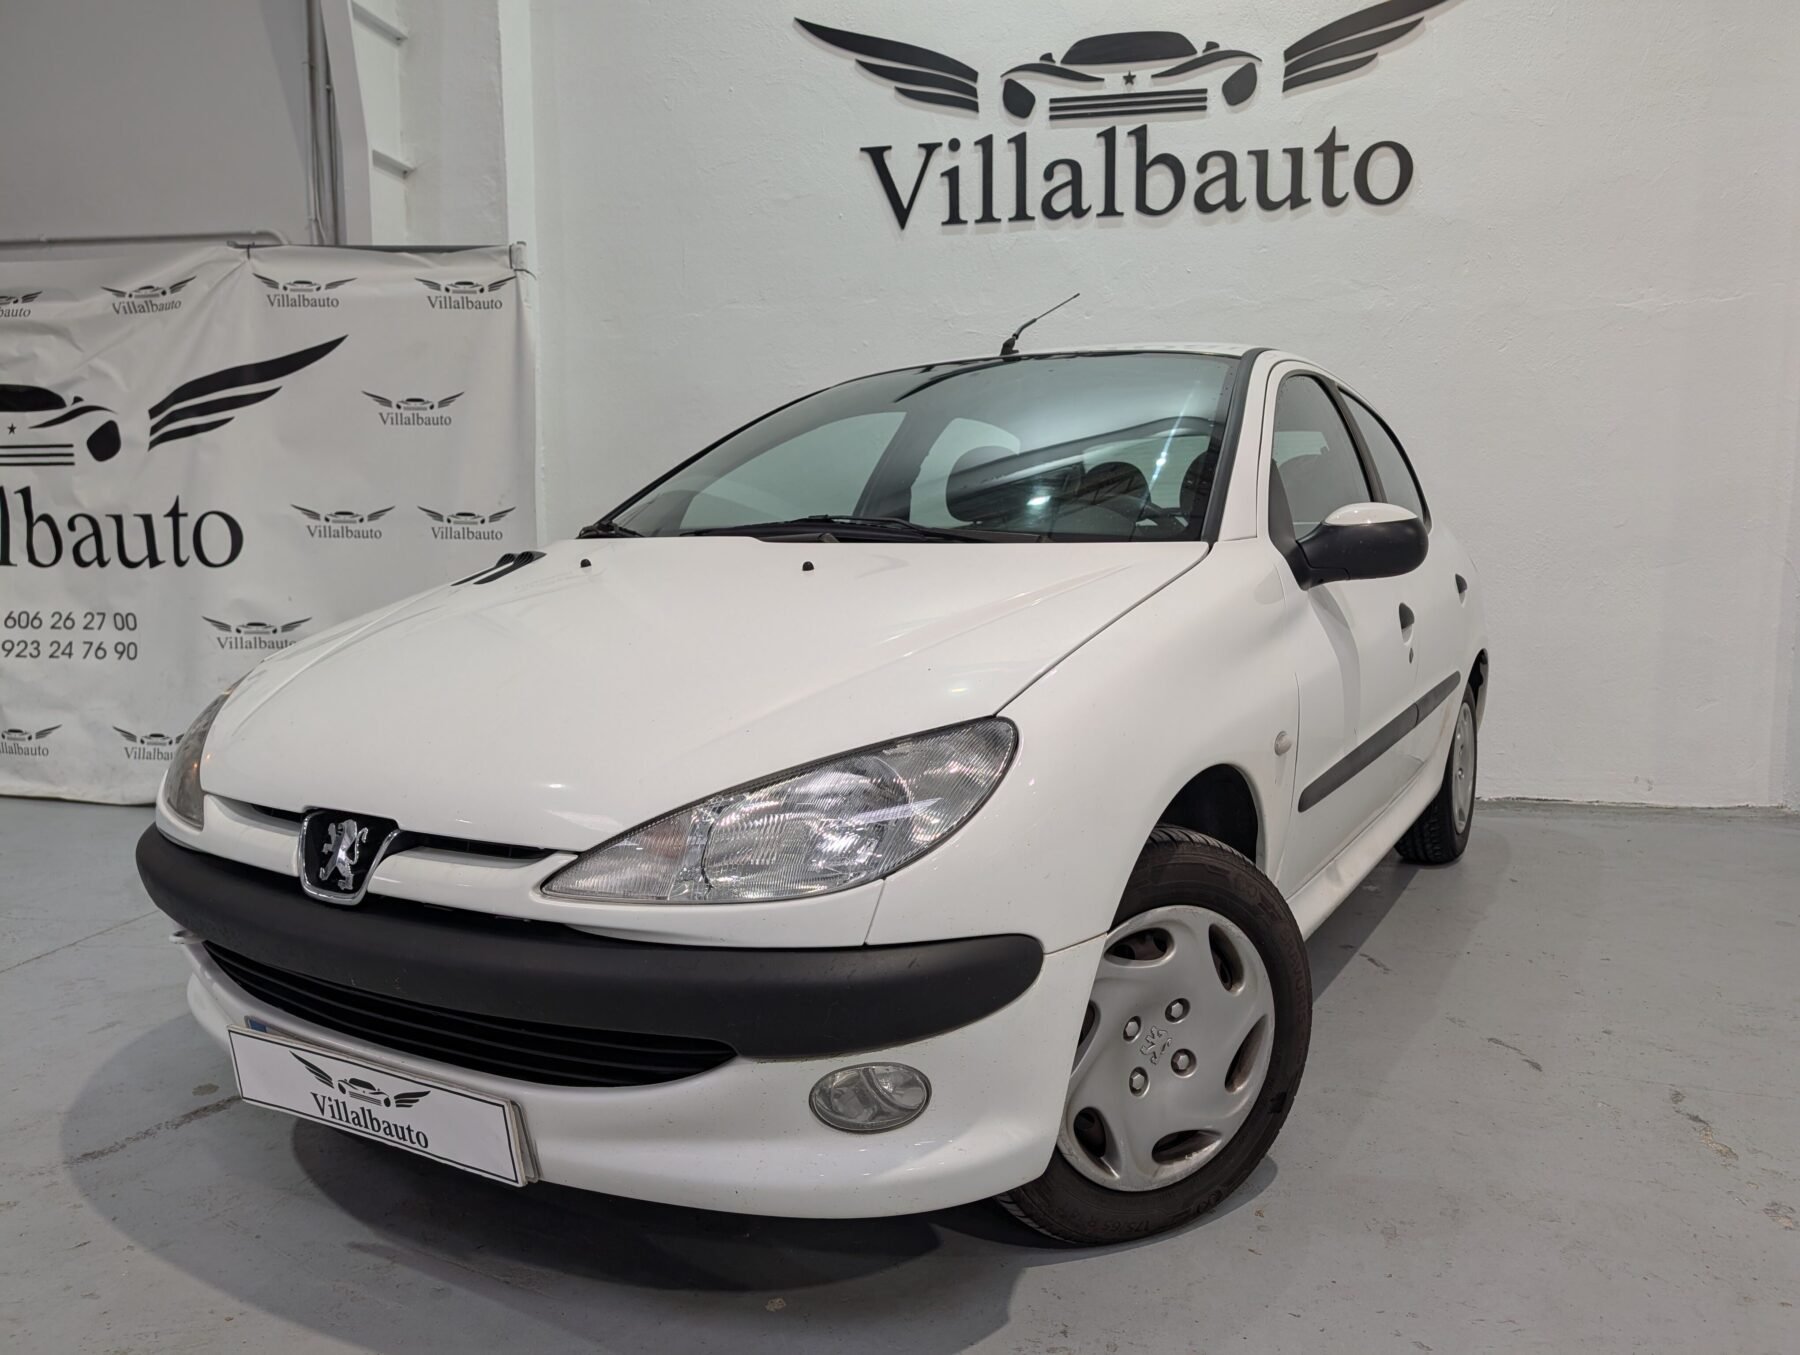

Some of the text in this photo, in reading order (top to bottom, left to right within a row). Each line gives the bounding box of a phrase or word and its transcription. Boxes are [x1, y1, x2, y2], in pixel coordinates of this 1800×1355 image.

[860, 124, 1414, 231] Villalbauto
[111, 298, 182, 316] Villalbauto
[266, 293, 340, 308] Villalbauto
[426, 295, 503, 310] Villalbauto
[378, 412, 452, 426] Villalbauto
[306, 525, 383, 540] Villalbauto
[431, 526, 504, 541] Villalbauto
[4, 610, 138, 632] 606 26 27 00
[1, 639, 138, 661] 923 24 76 90
[310, 1092, 429, 1149] Villalbauto
